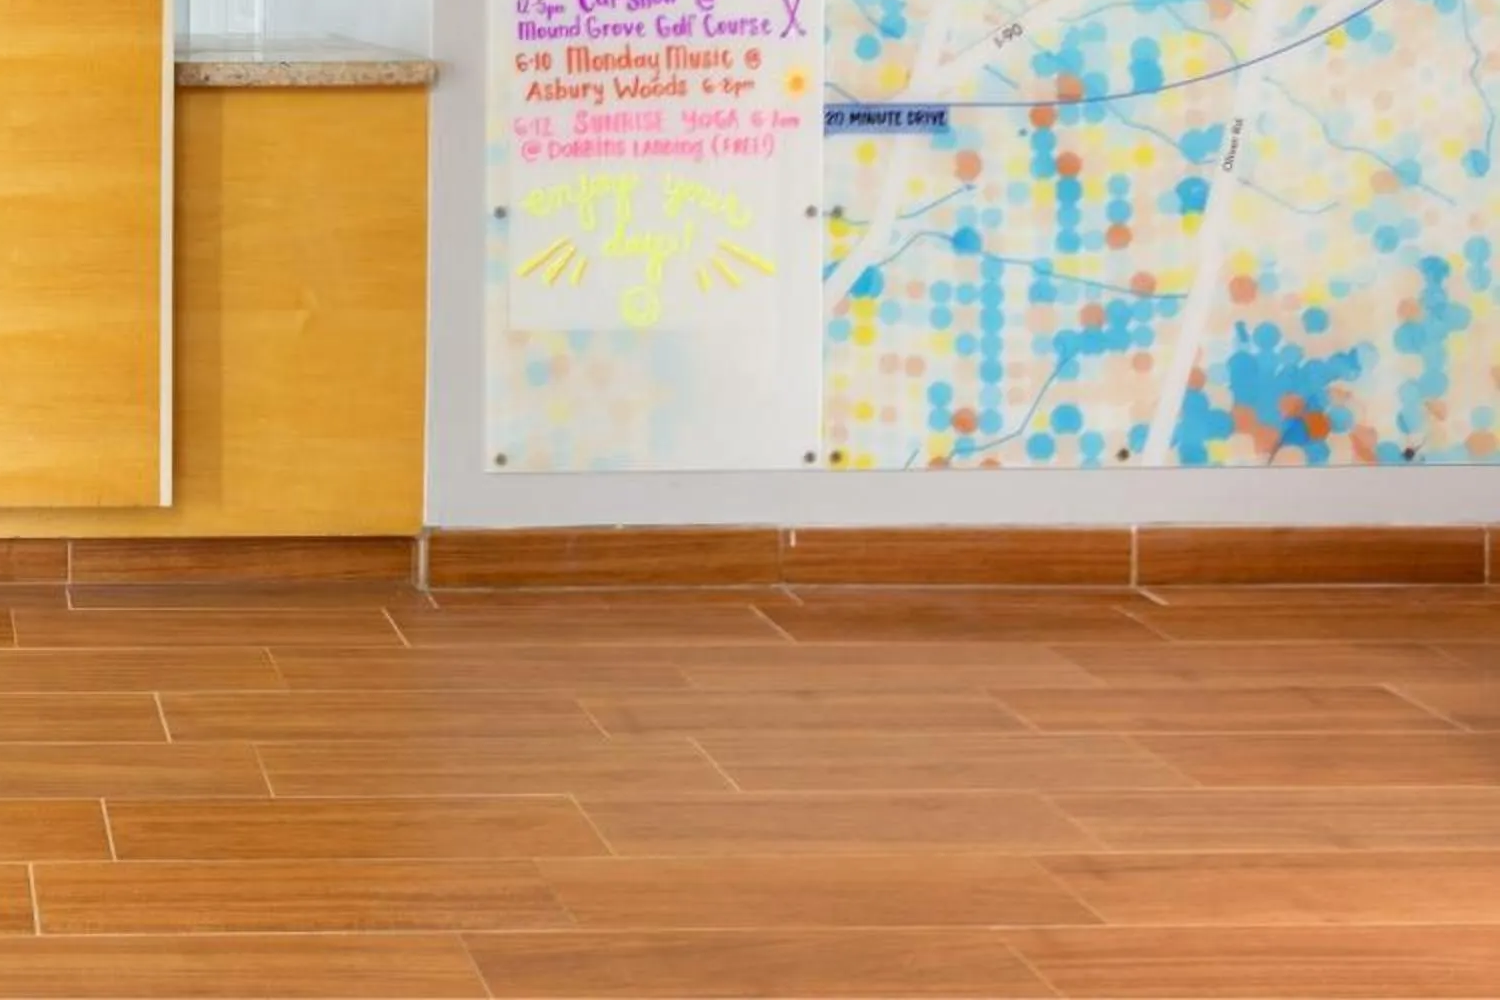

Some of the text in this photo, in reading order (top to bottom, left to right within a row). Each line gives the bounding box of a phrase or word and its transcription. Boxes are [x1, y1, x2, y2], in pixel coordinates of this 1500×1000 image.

[586, 16, 645, 38] Grove
[703, 13, 773, 38] Course
[992, 22, 1024, 50] I-90
[566, 44, 660, 80] Monday
[665, 44, 733, 71] Music
[525, 77, 605, 105] Asbury
[613, 76, 689, 99] Woods
[826, 111, 947, 126] 20 MINUTE DRIVE
[1231, 118, 1244, 135] Rd
